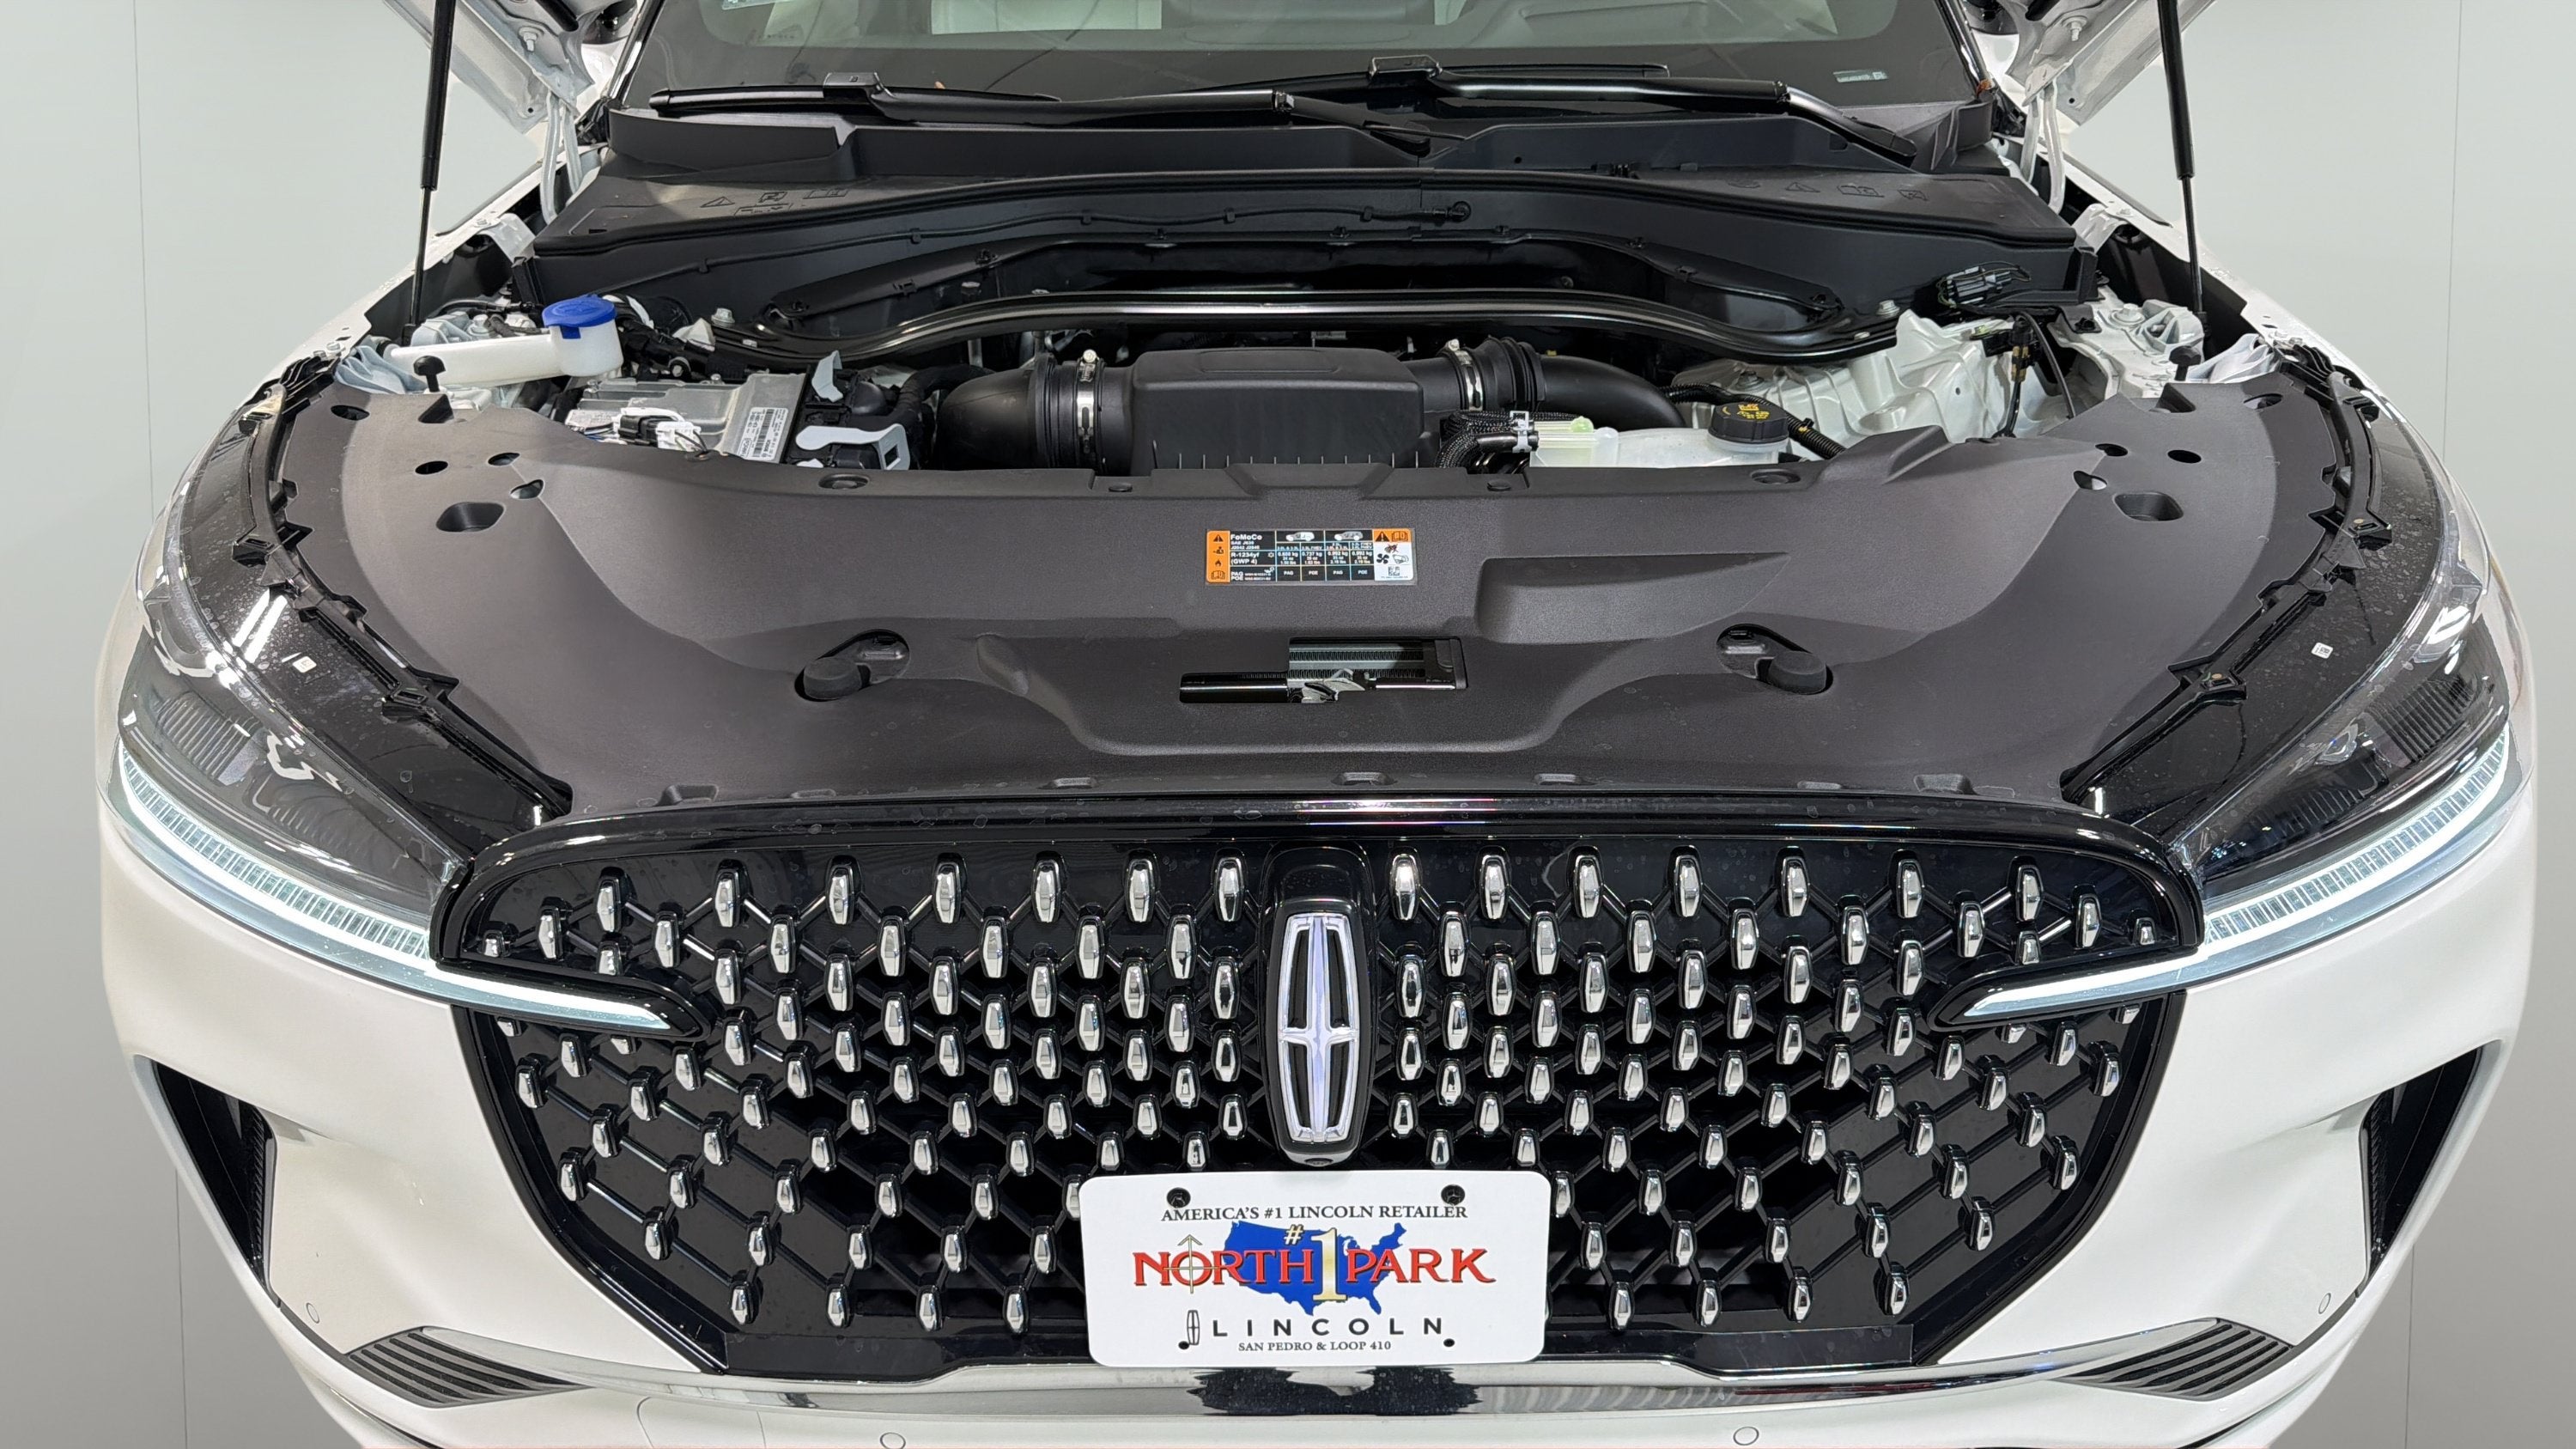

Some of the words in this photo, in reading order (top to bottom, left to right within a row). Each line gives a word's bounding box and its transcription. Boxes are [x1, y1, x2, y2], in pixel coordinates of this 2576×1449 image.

[1161, 1206, 1260, 1221] AMERICA'S
[1264, 1207, 1283, 1220] #1
[1288, 1205, 1374, 1219] LINCOLN
[1378, 1205, 1468, 1218] RETAILER
[1133, 1249, 1314, 1287] NORTH
[1346, 1248, 1498, 1284] PARK
[1212, 1317, 1443, 1337] LINCOLN
[1238, 1342, 1264, 1352] SAN
[1267, 1342, 1313, 1352] PEDRO
[1316, 1342, 1327, 1352] &
[1330, 1341, 1368, 1351] LOOP
[1370, 1341, 1392, 1351] 410
